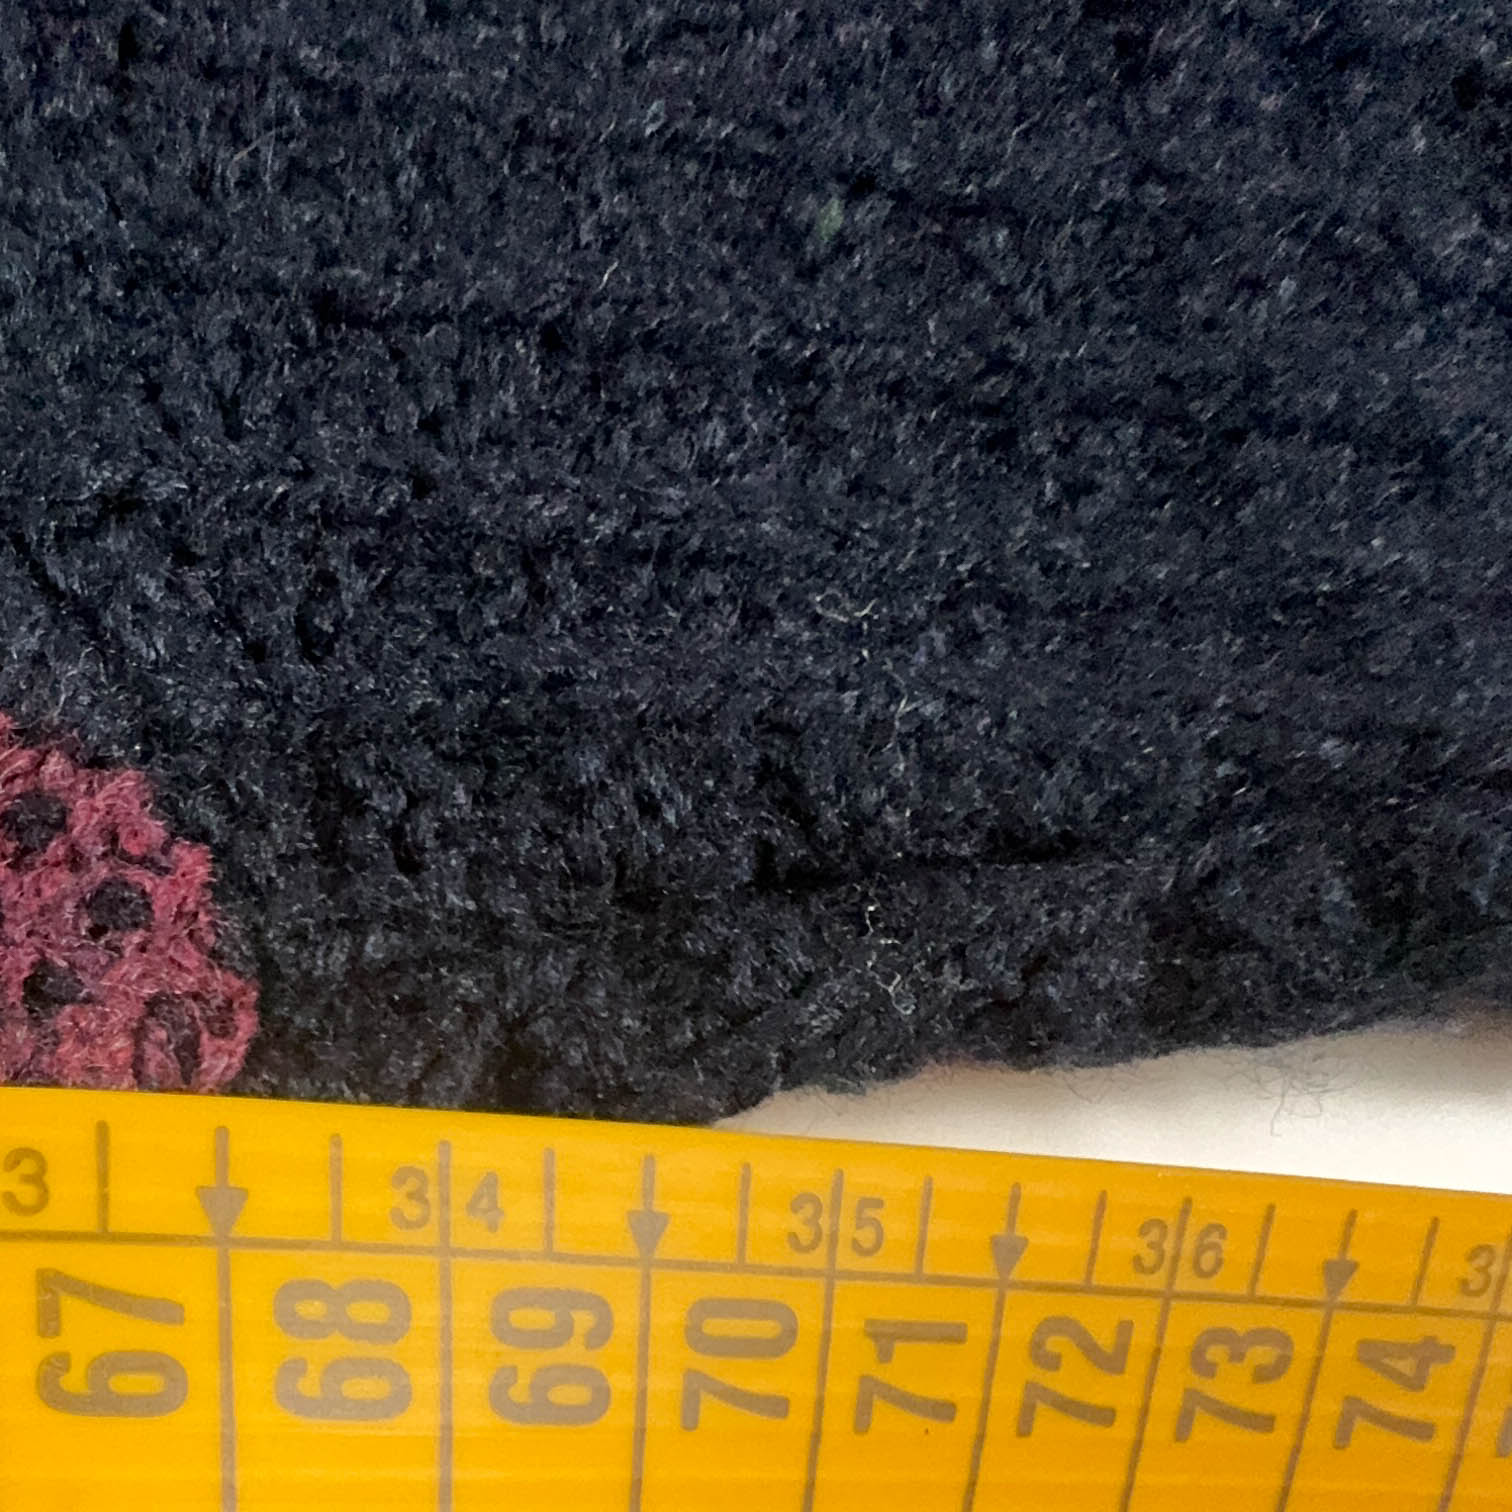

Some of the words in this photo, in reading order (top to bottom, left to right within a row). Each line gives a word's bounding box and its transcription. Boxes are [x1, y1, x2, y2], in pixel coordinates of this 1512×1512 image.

[390, 1165, 504, 1233] 34
[787, 1192, 884, 1256] 35
[1132, 1219, 1227, 1279] 36
[1459, 1243, 1494, 1298] 3
[35, 1267, 189, 1419] 67
[273, 1279, 413, 1422] 68
[488, 1287, 614, 1427] 69
[680, 1297, 799, 1432] 70
[853, 1317, 967, 1435] 71
[1016, 1315, 1135, 1438] 72
[1174, 1326, 1294, 1443] 73
[1333, 1335, 1456, 1451] 74
